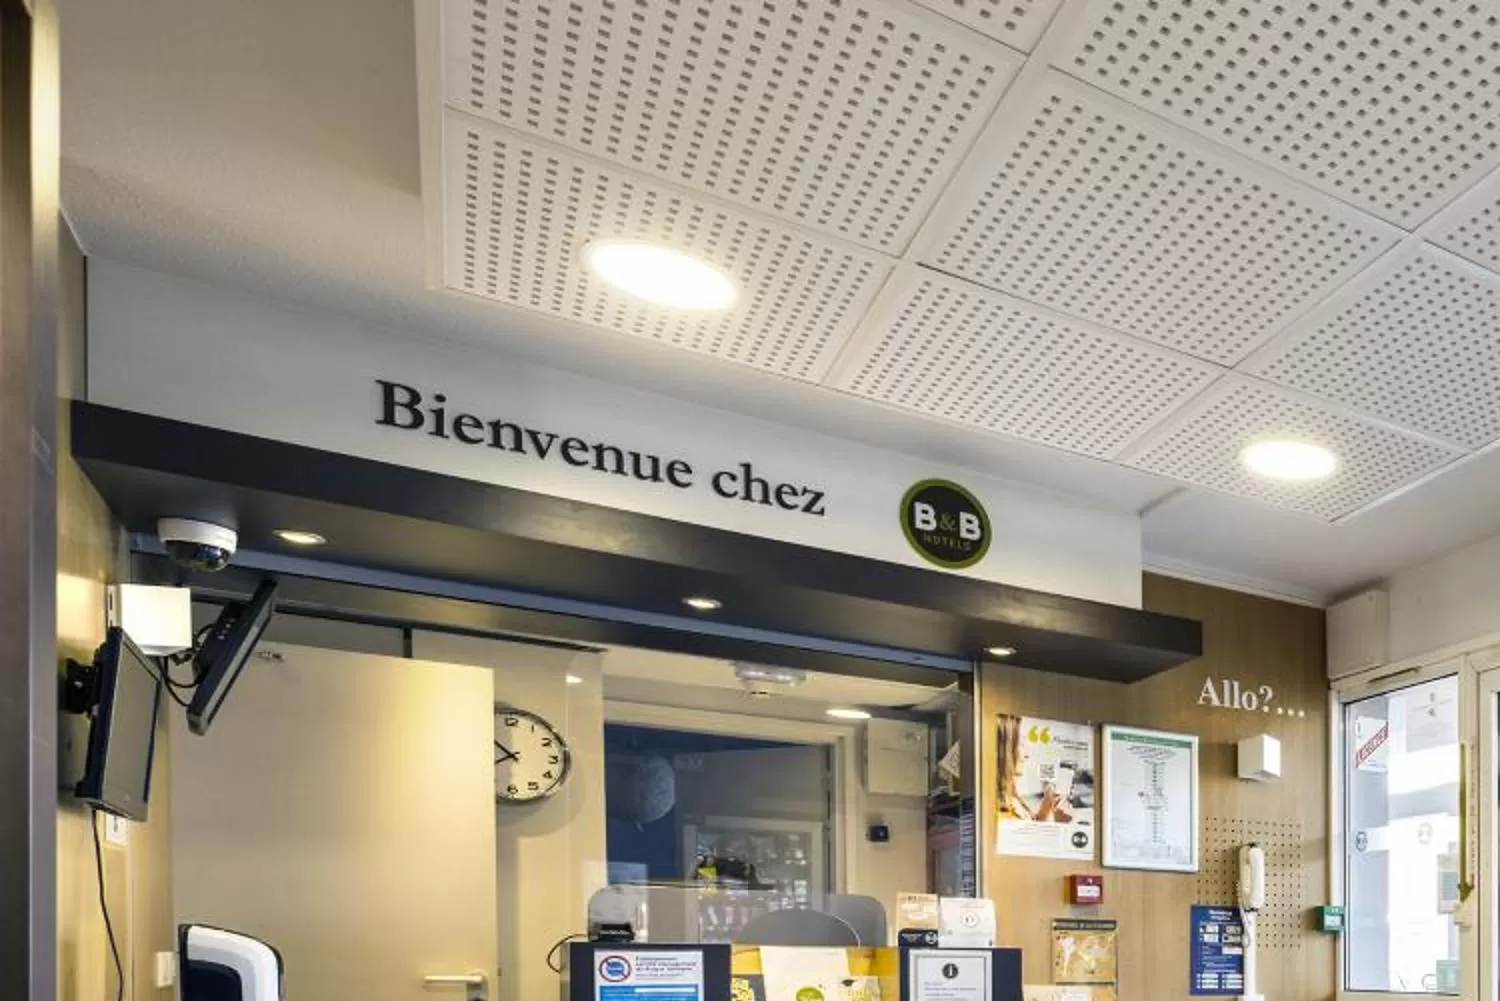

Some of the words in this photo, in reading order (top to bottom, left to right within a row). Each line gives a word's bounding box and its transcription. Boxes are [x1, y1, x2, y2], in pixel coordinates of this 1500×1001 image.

[374, 379, 694, 489] Bienvenue
[711, 463, 827, 517] chez
[914, 501, 982, 541] B&B
